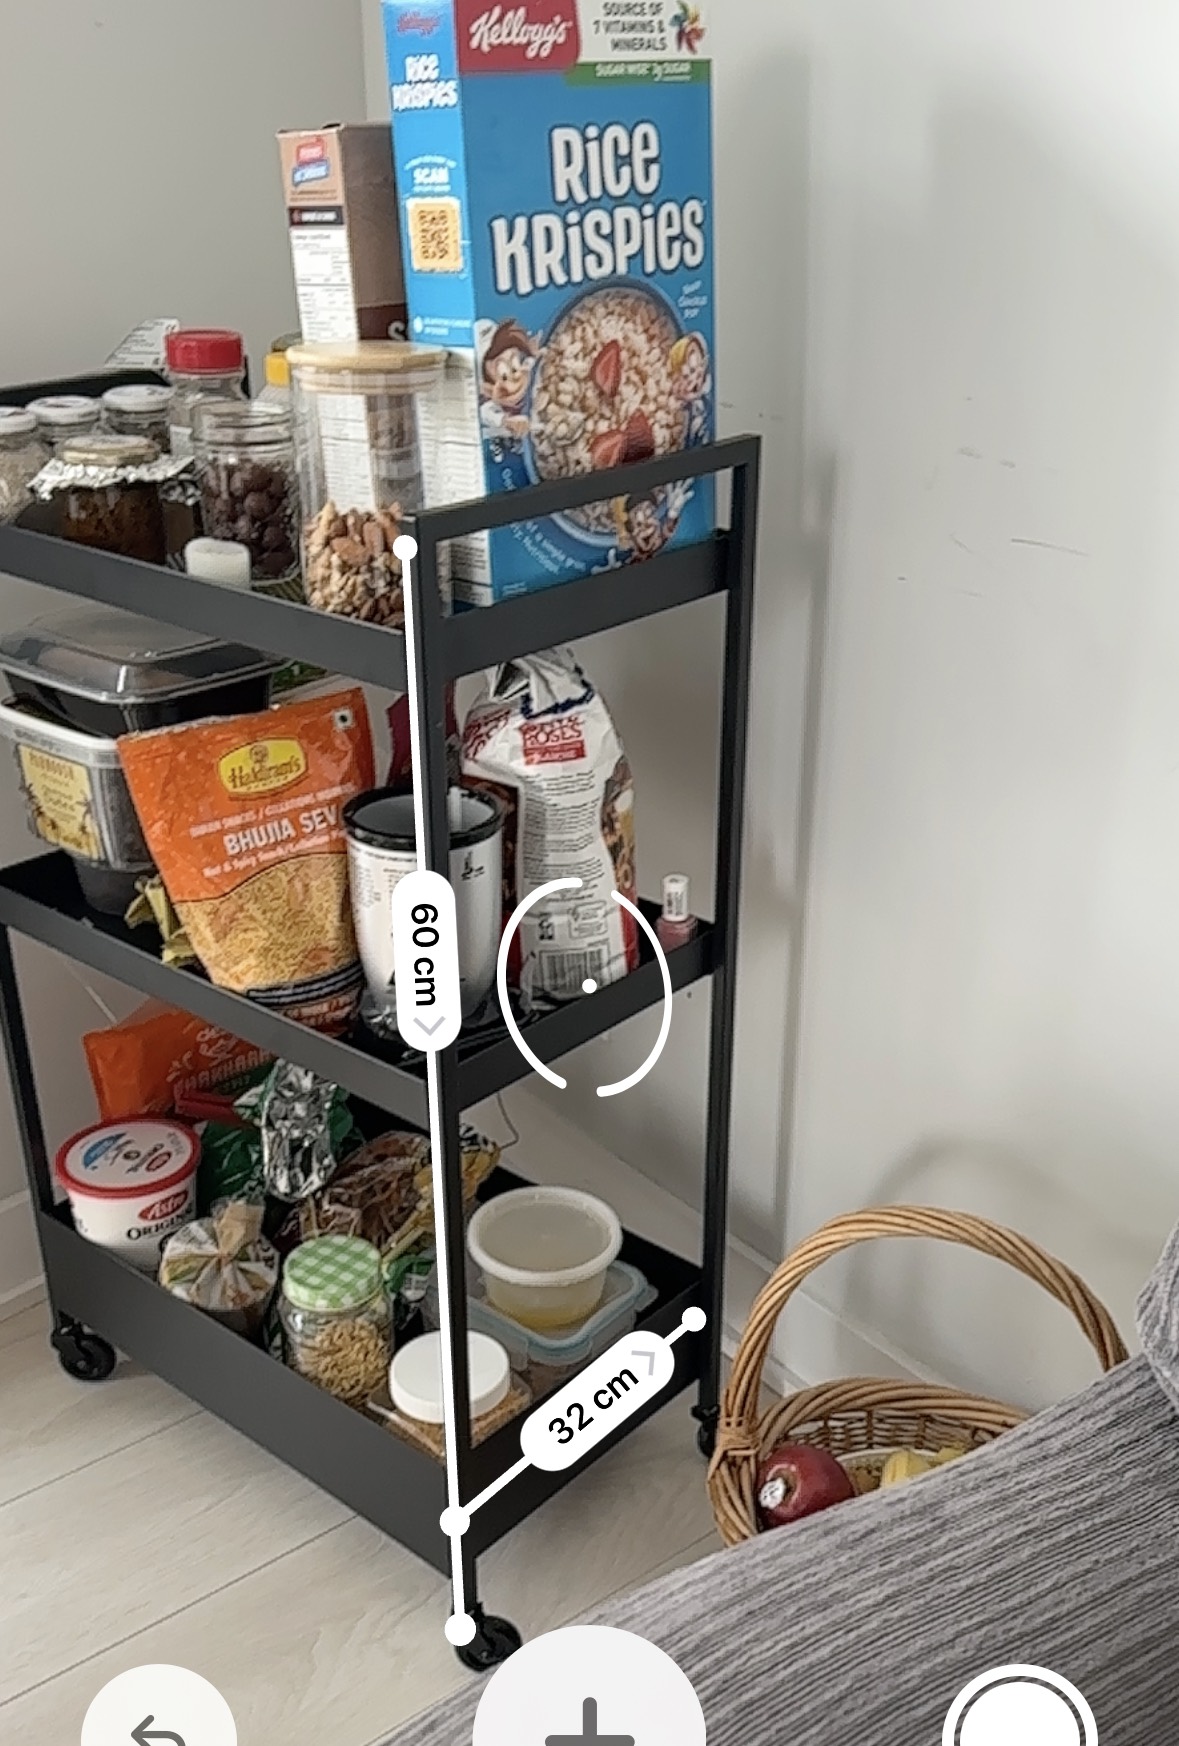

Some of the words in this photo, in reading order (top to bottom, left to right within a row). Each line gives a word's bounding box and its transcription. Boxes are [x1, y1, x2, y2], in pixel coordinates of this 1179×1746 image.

[469, 6, 573, 59] Kellogg's
[603, 19, 656, 35] VITAMINS
[611, 37, 668, 52] MINERALS
[223, 817, 298, 857] BHUJIA
[299, 804, 338, 834] SEV
